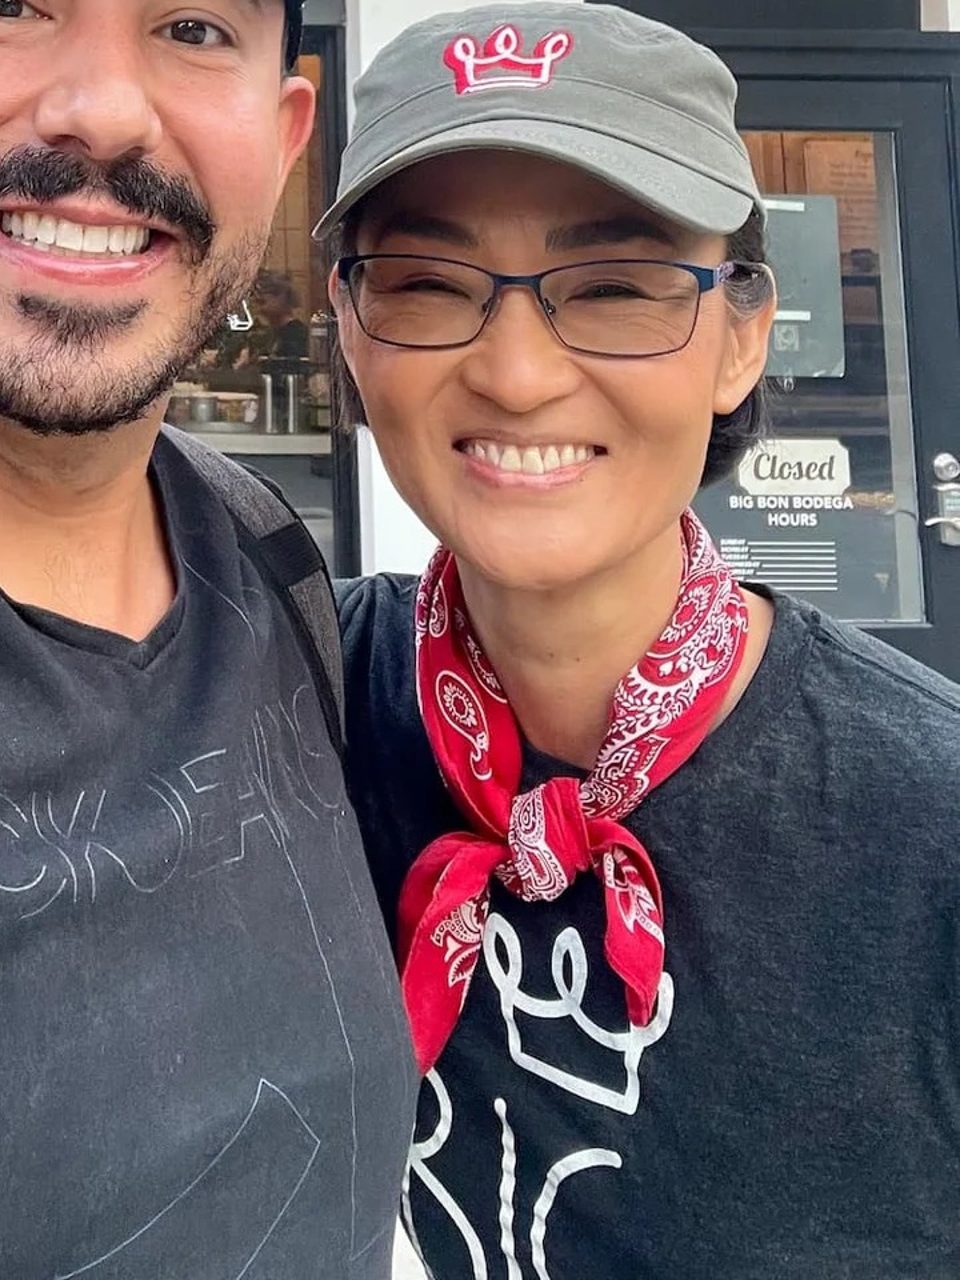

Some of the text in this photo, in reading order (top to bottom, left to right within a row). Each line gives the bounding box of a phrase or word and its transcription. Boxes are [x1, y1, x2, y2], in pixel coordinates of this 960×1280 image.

[752, 452, 836, 481] Closed
[729, 495, 854, 510] BIG BON BODEGA
[767, 512, 818, 527] HOURS
